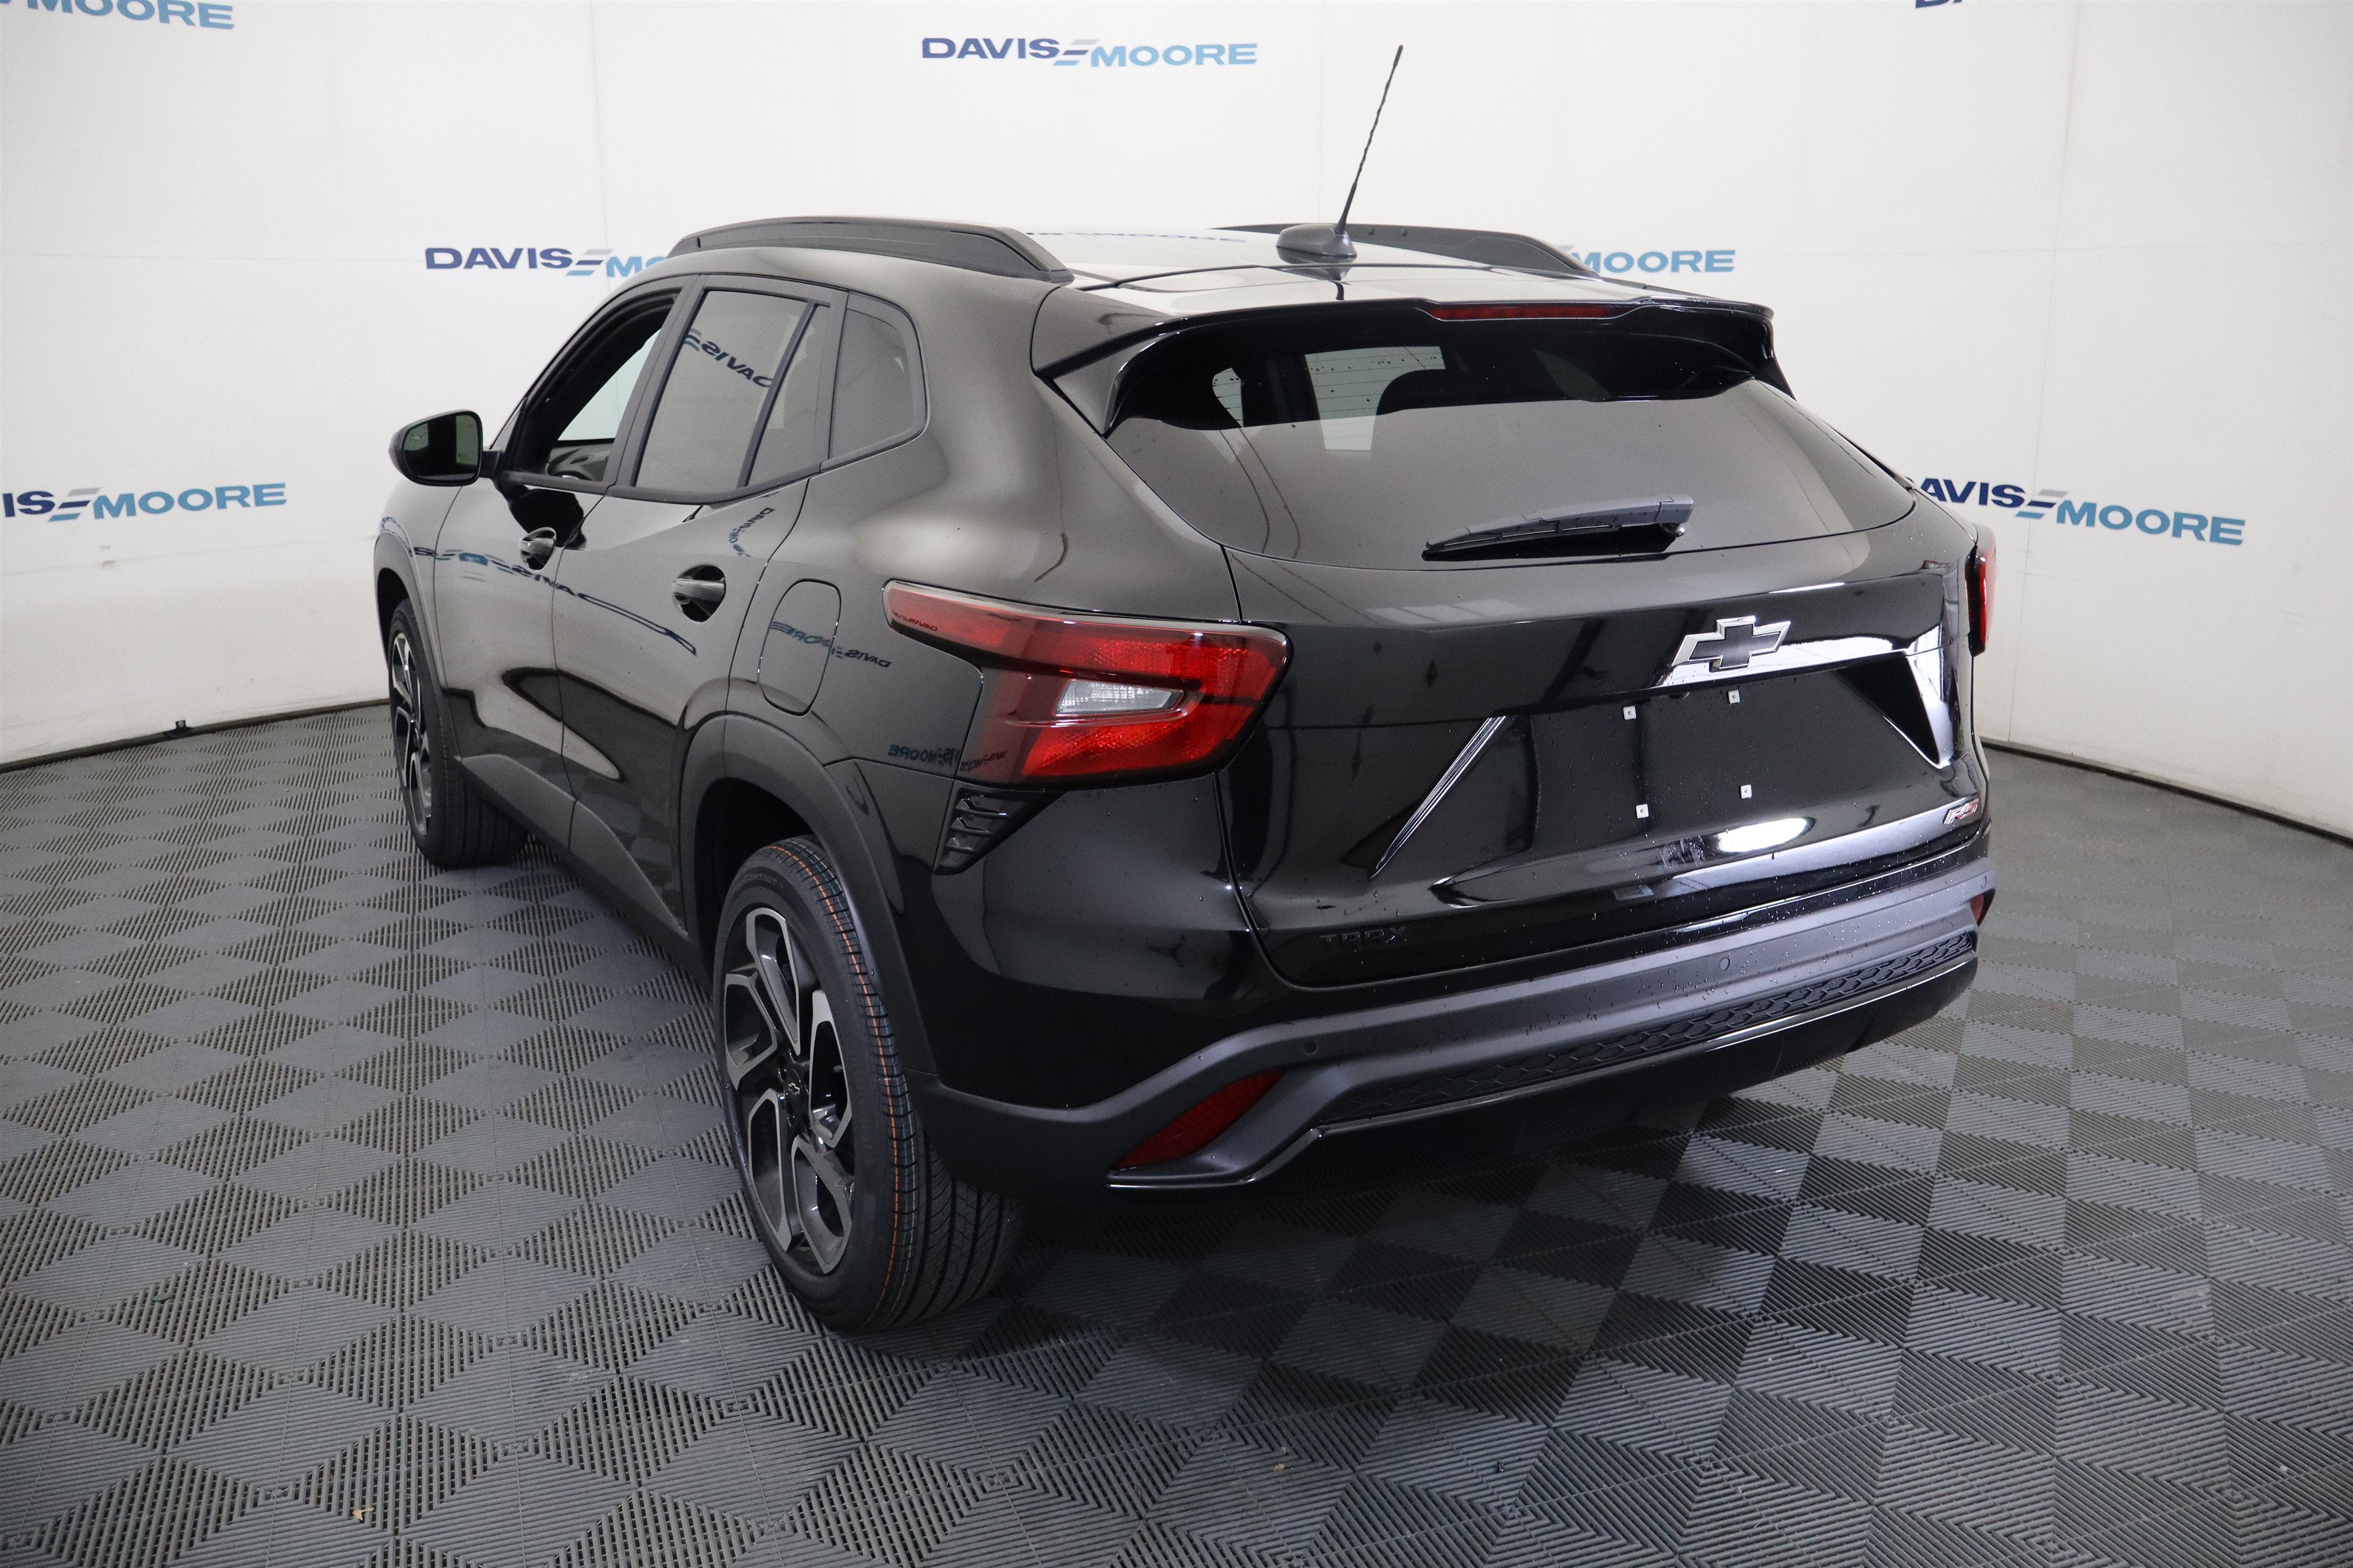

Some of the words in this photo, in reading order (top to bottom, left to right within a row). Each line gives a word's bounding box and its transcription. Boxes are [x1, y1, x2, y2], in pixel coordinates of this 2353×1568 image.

[922, 38, 1059, 60] DAVIS
[1090, 43, 1258, 67] MOORE
[425, 248, 573, 270] DAVIS
[92, 482, 287, 520] MOORE
[1905, 476, 2026, 509] AVIS
[2055, 499, 2245, 546] MOORE
[1942, 798, 1979, 824] RS
